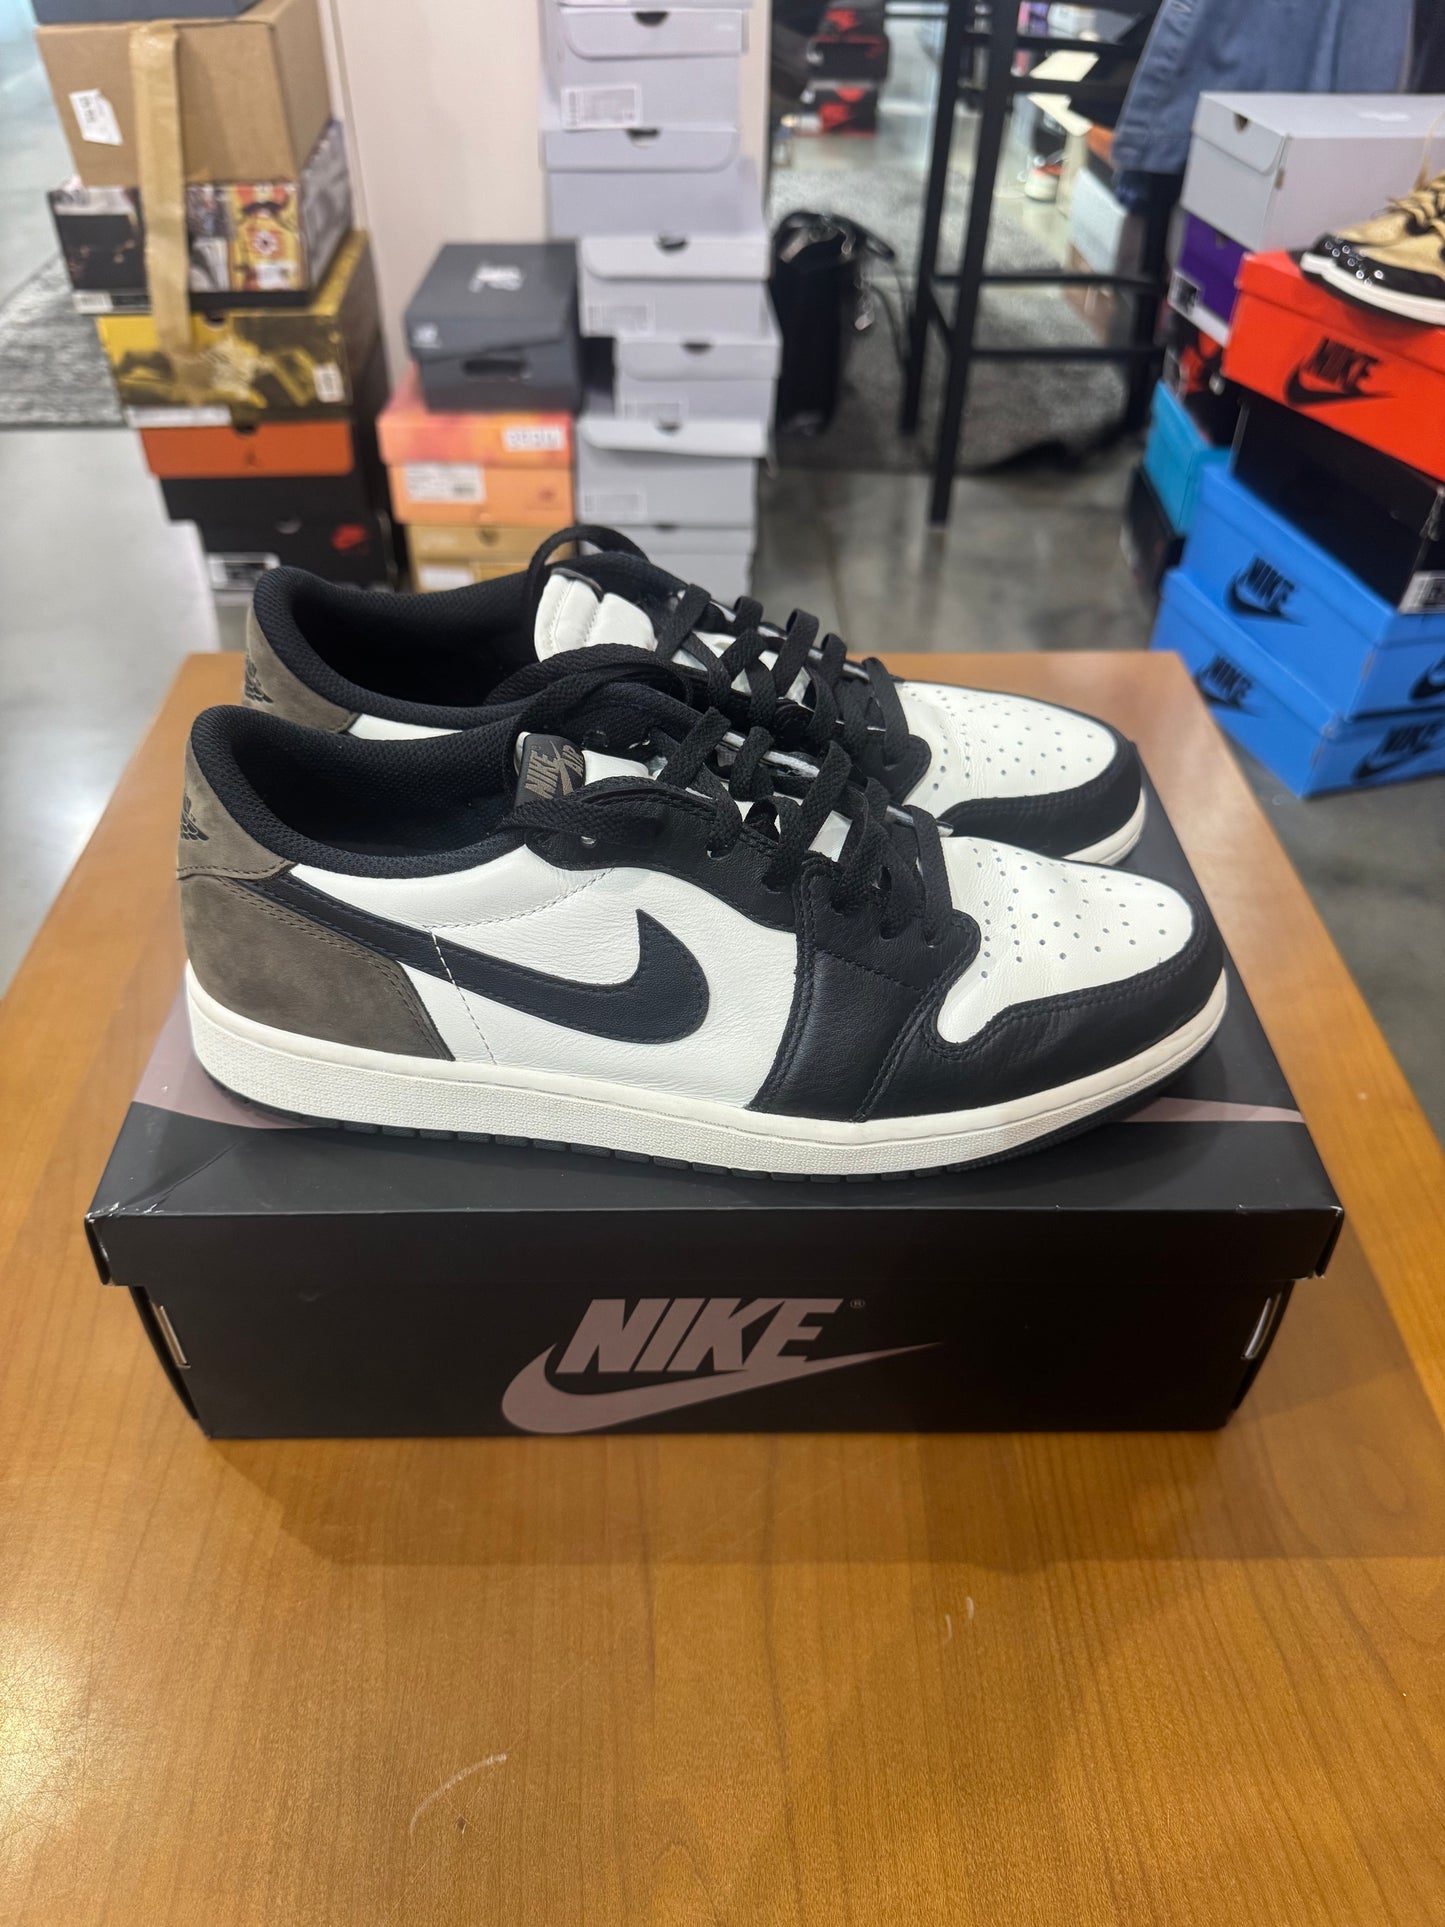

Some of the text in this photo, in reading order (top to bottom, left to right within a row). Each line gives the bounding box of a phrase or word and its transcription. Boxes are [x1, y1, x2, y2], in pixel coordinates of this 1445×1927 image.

[1303, 337, 1381, 395] NIKE
[1239, 556, 1296, 615] NIKE
[1202, 655, 1253, 706] NIKE
[524, 750, 560, 800] NIKE
[555, 1298, 844, 1374] NIKE
